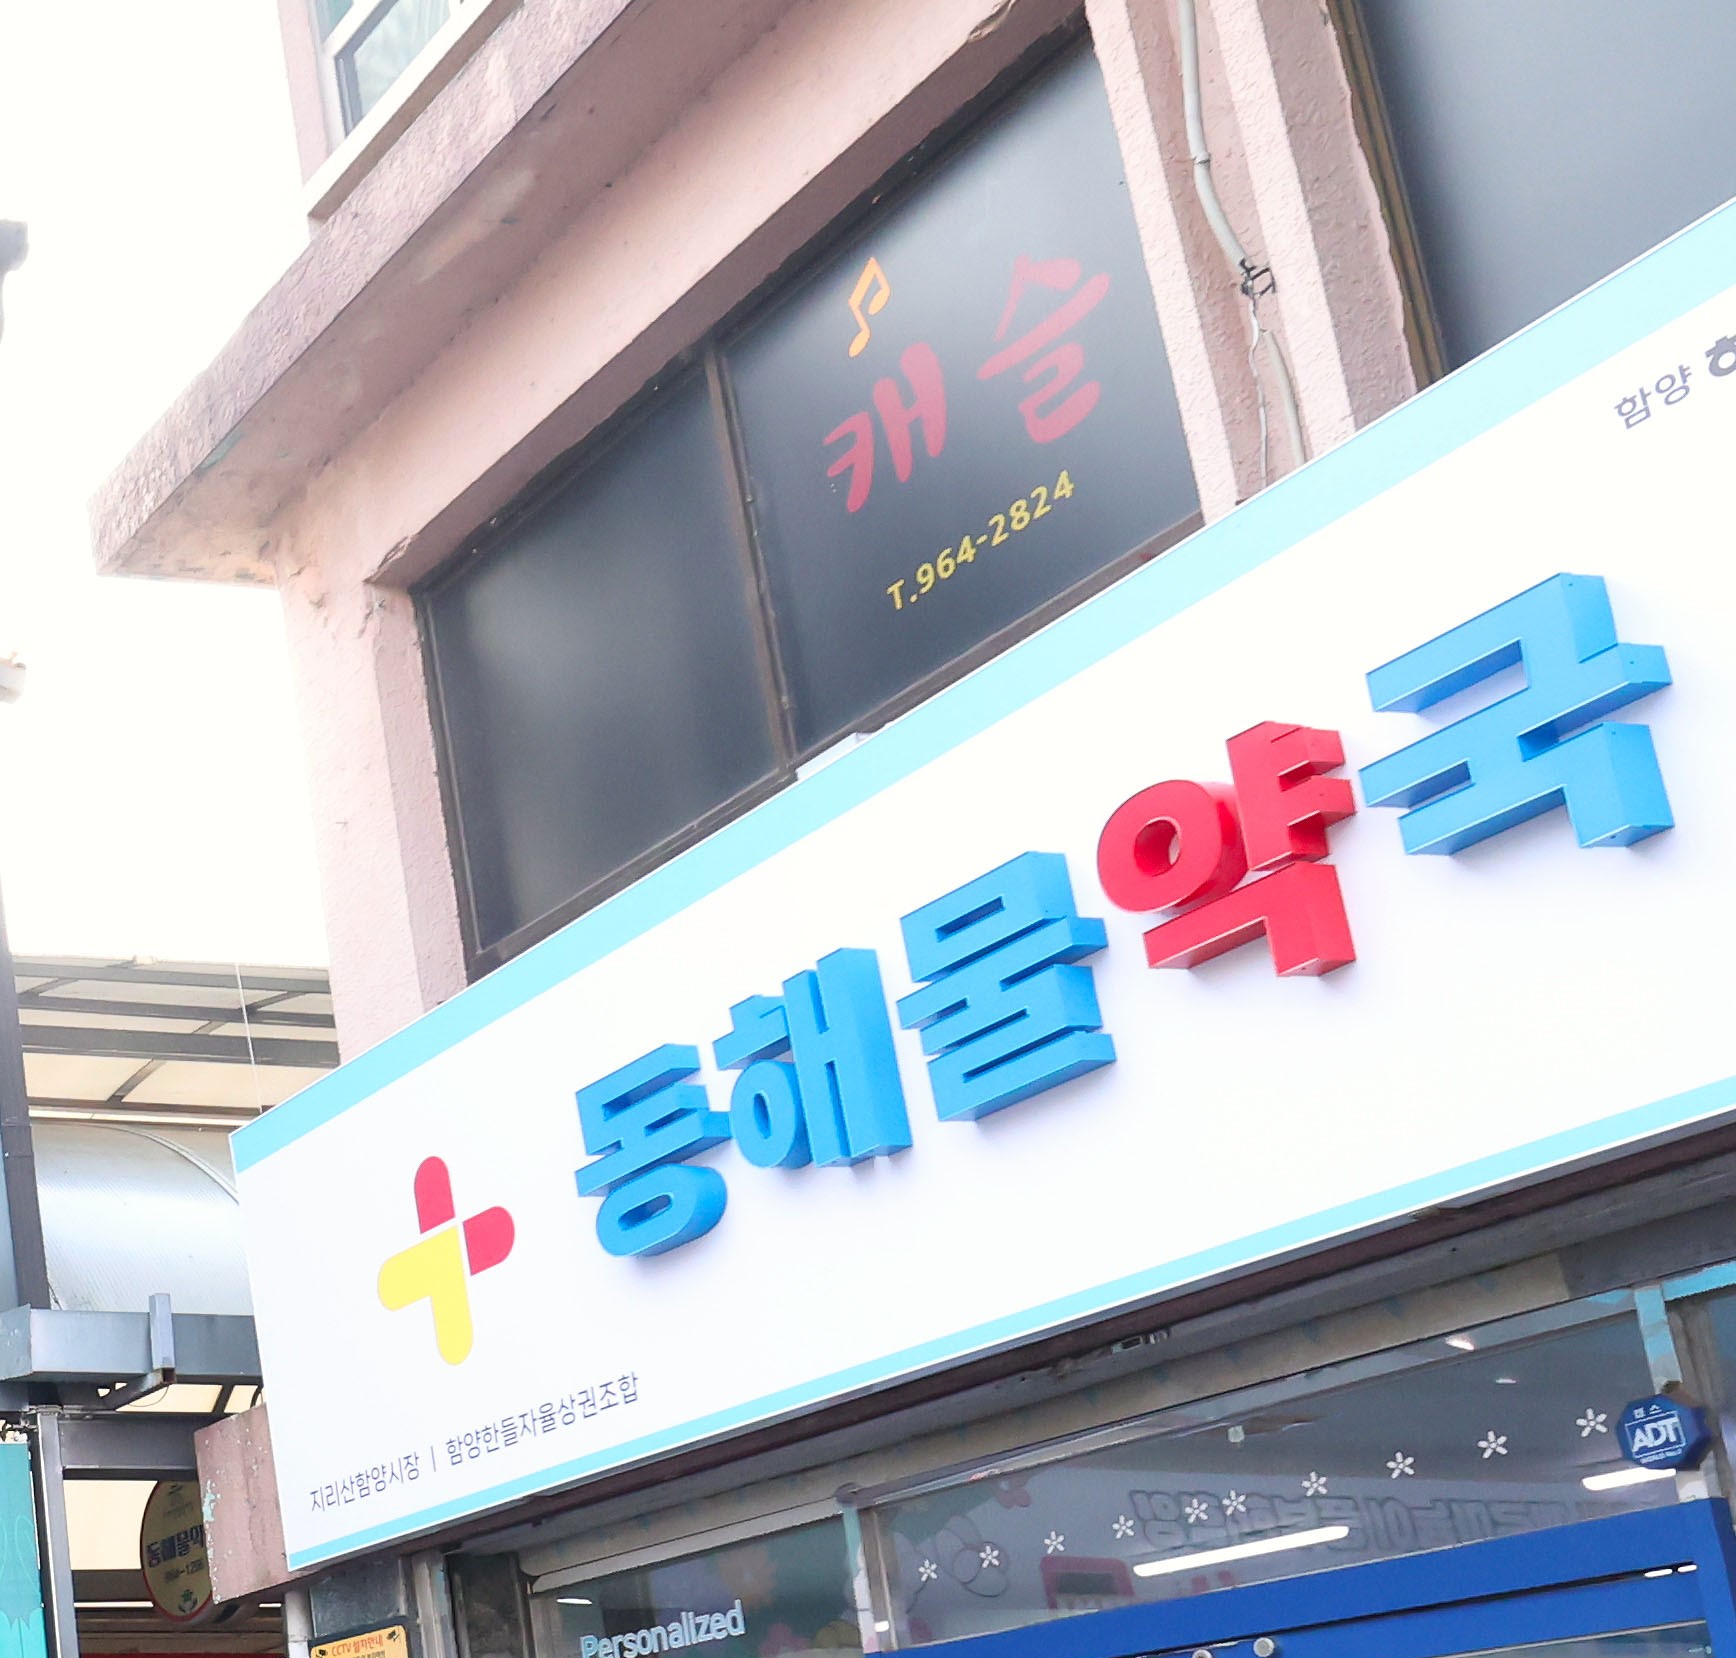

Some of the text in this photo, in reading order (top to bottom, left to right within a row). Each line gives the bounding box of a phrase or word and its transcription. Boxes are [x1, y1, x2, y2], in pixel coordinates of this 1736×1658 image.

[822, 254, 1111, 513] 캐슬
[1612, 364, 1693, 430] 함양
[886, 469, 1076, 611] T.964-2824
[573, 572, 1674, 1258] 동해물약국
[310, 1371, 639, 1512] 지리산함양시장 함양한들자율상권조합
[1632, 1417, 1679, 1452] ADT
